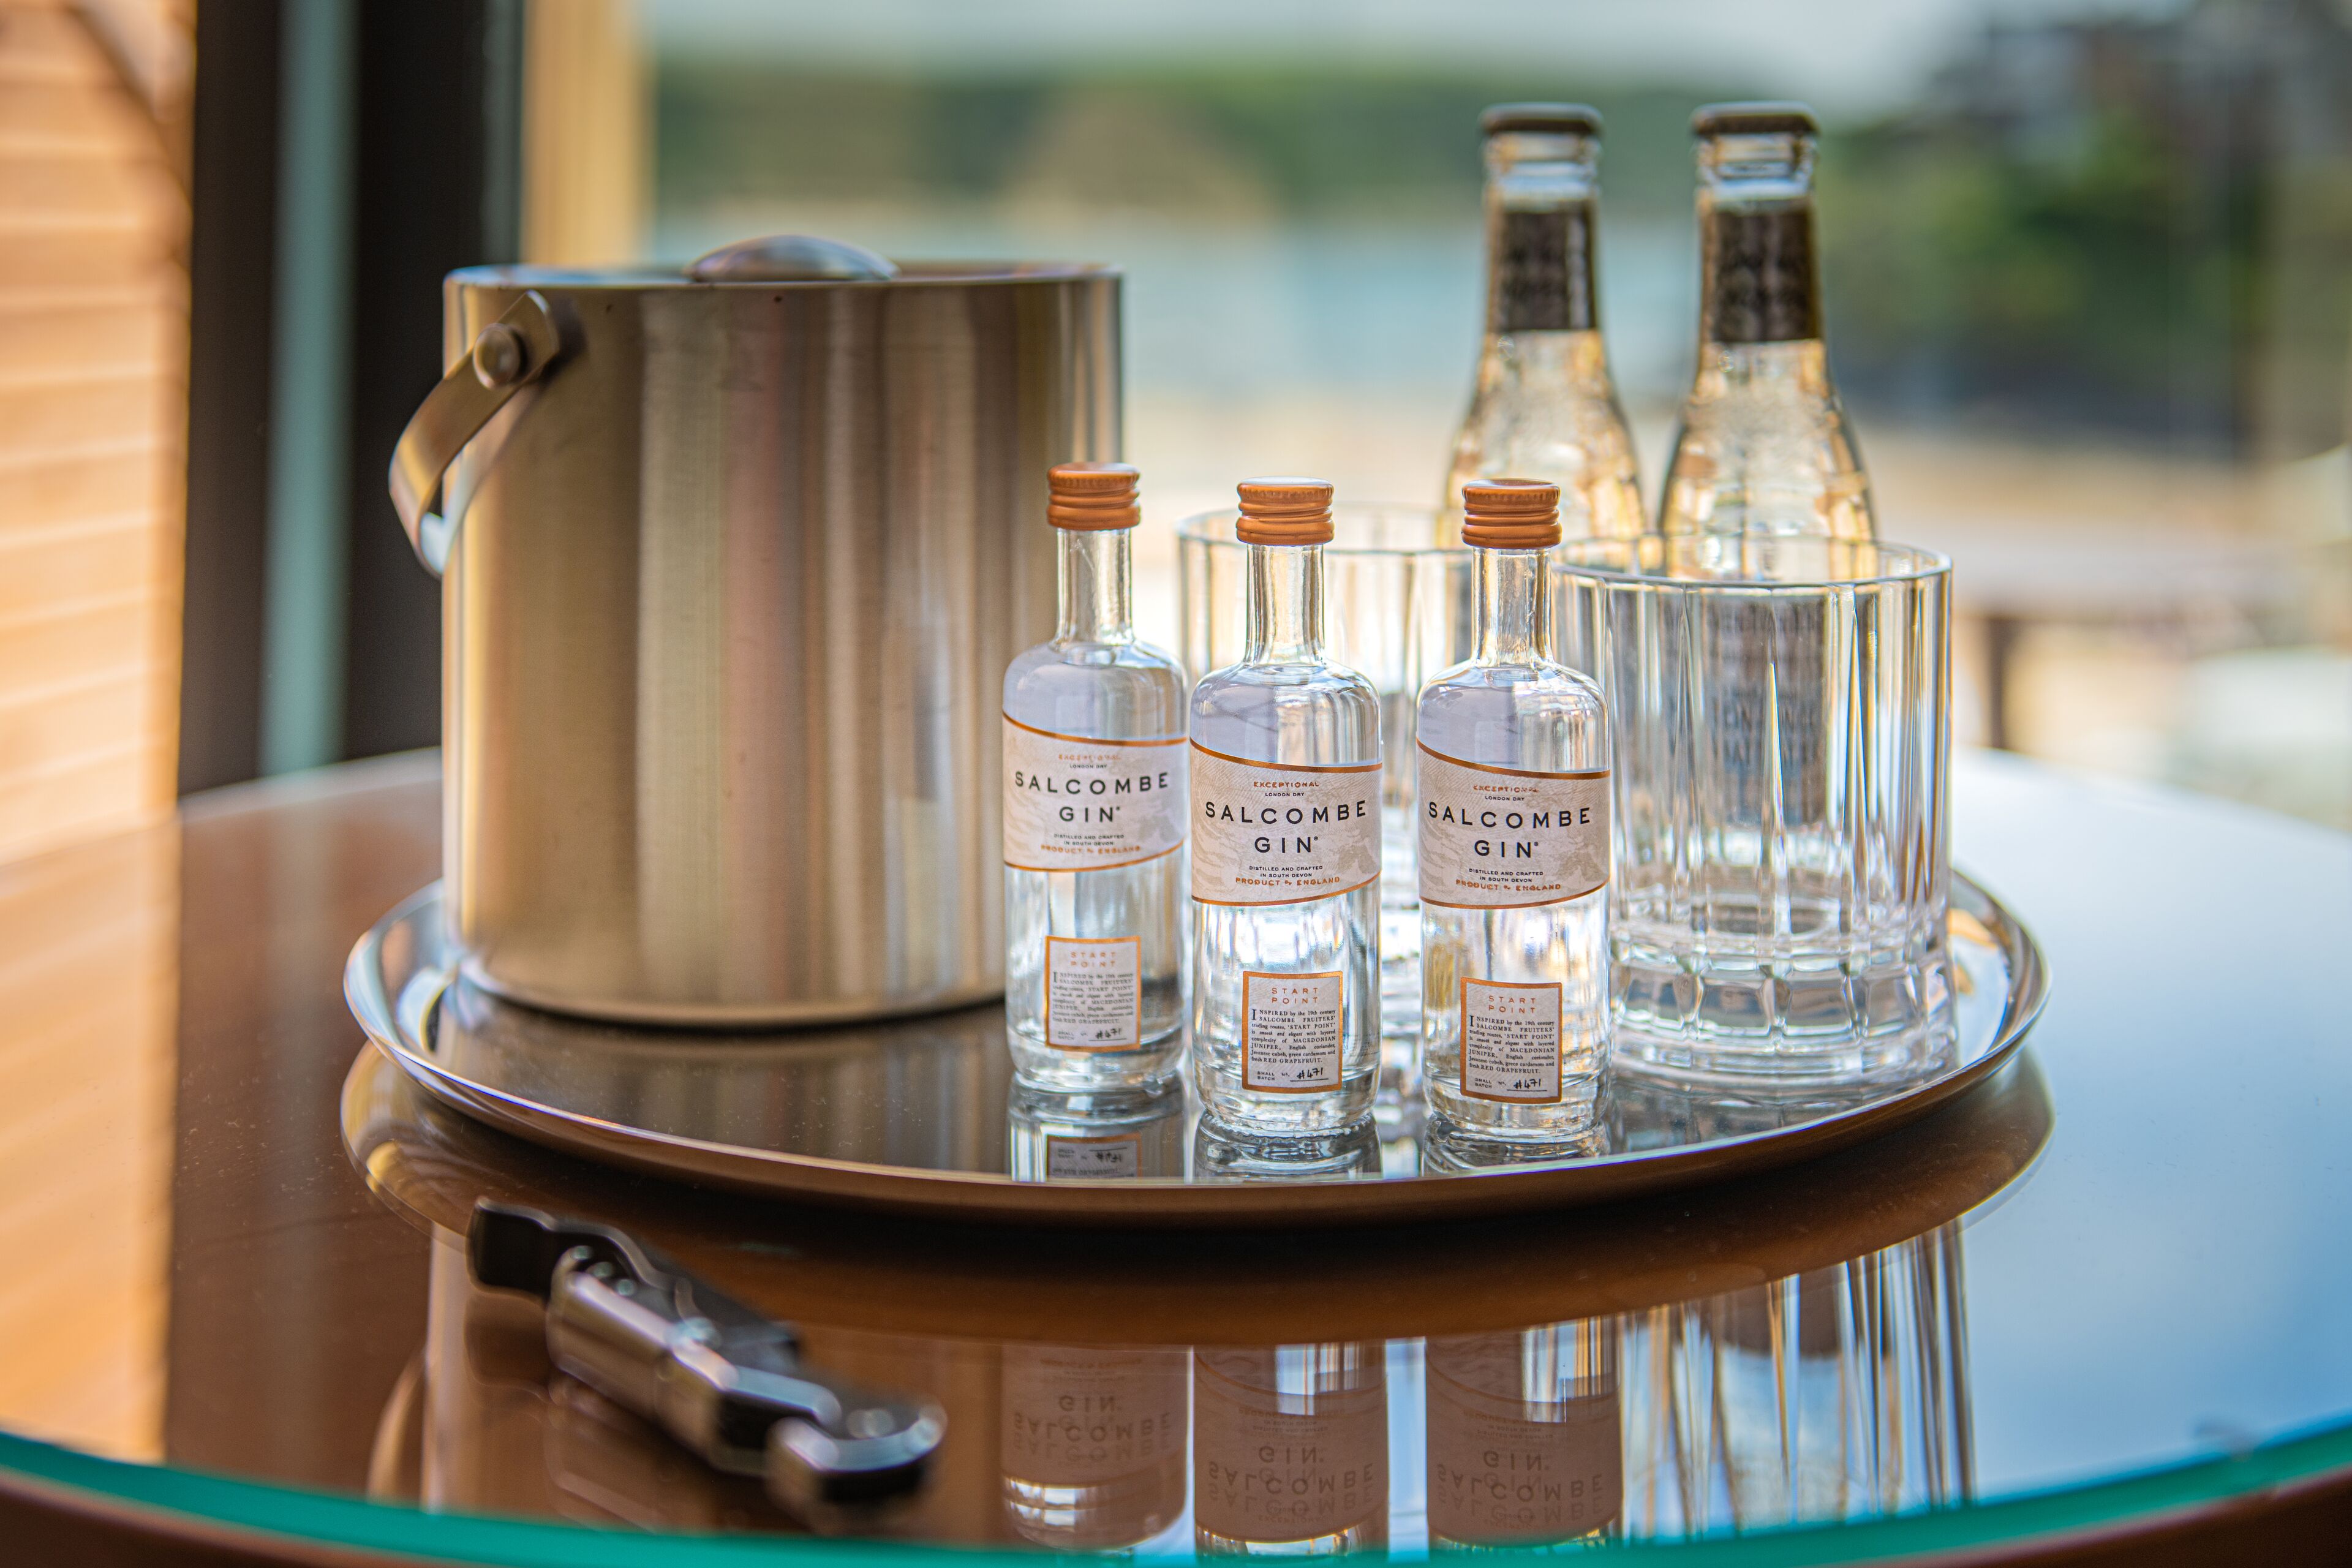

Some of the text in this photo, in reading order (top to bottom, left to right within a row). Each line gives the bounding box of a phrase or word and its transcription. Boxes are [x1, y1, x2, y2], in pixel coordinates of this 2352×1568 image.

[1015, 771, 1168, 795] SALCOMBE
[1205, 800, 1366, 824] SALCOMBE
[1429, 802, 1590, 829] SALCOMBE
[1235, 877, 1280, 886] PRODUCT
[1297, 876, 1340, 886] ENGLAND
[1456, 879, 1499, 890] PRODUCT
[1488, 995, 1536, 1004] START
[1488, 1005, 1536, 1014] POINT
[1469, 1049, 1498, 1058] JUNIPER,
[1297, 1067, 1323, 1079] #471
[1513, 1078, 1541, 1090] #471
